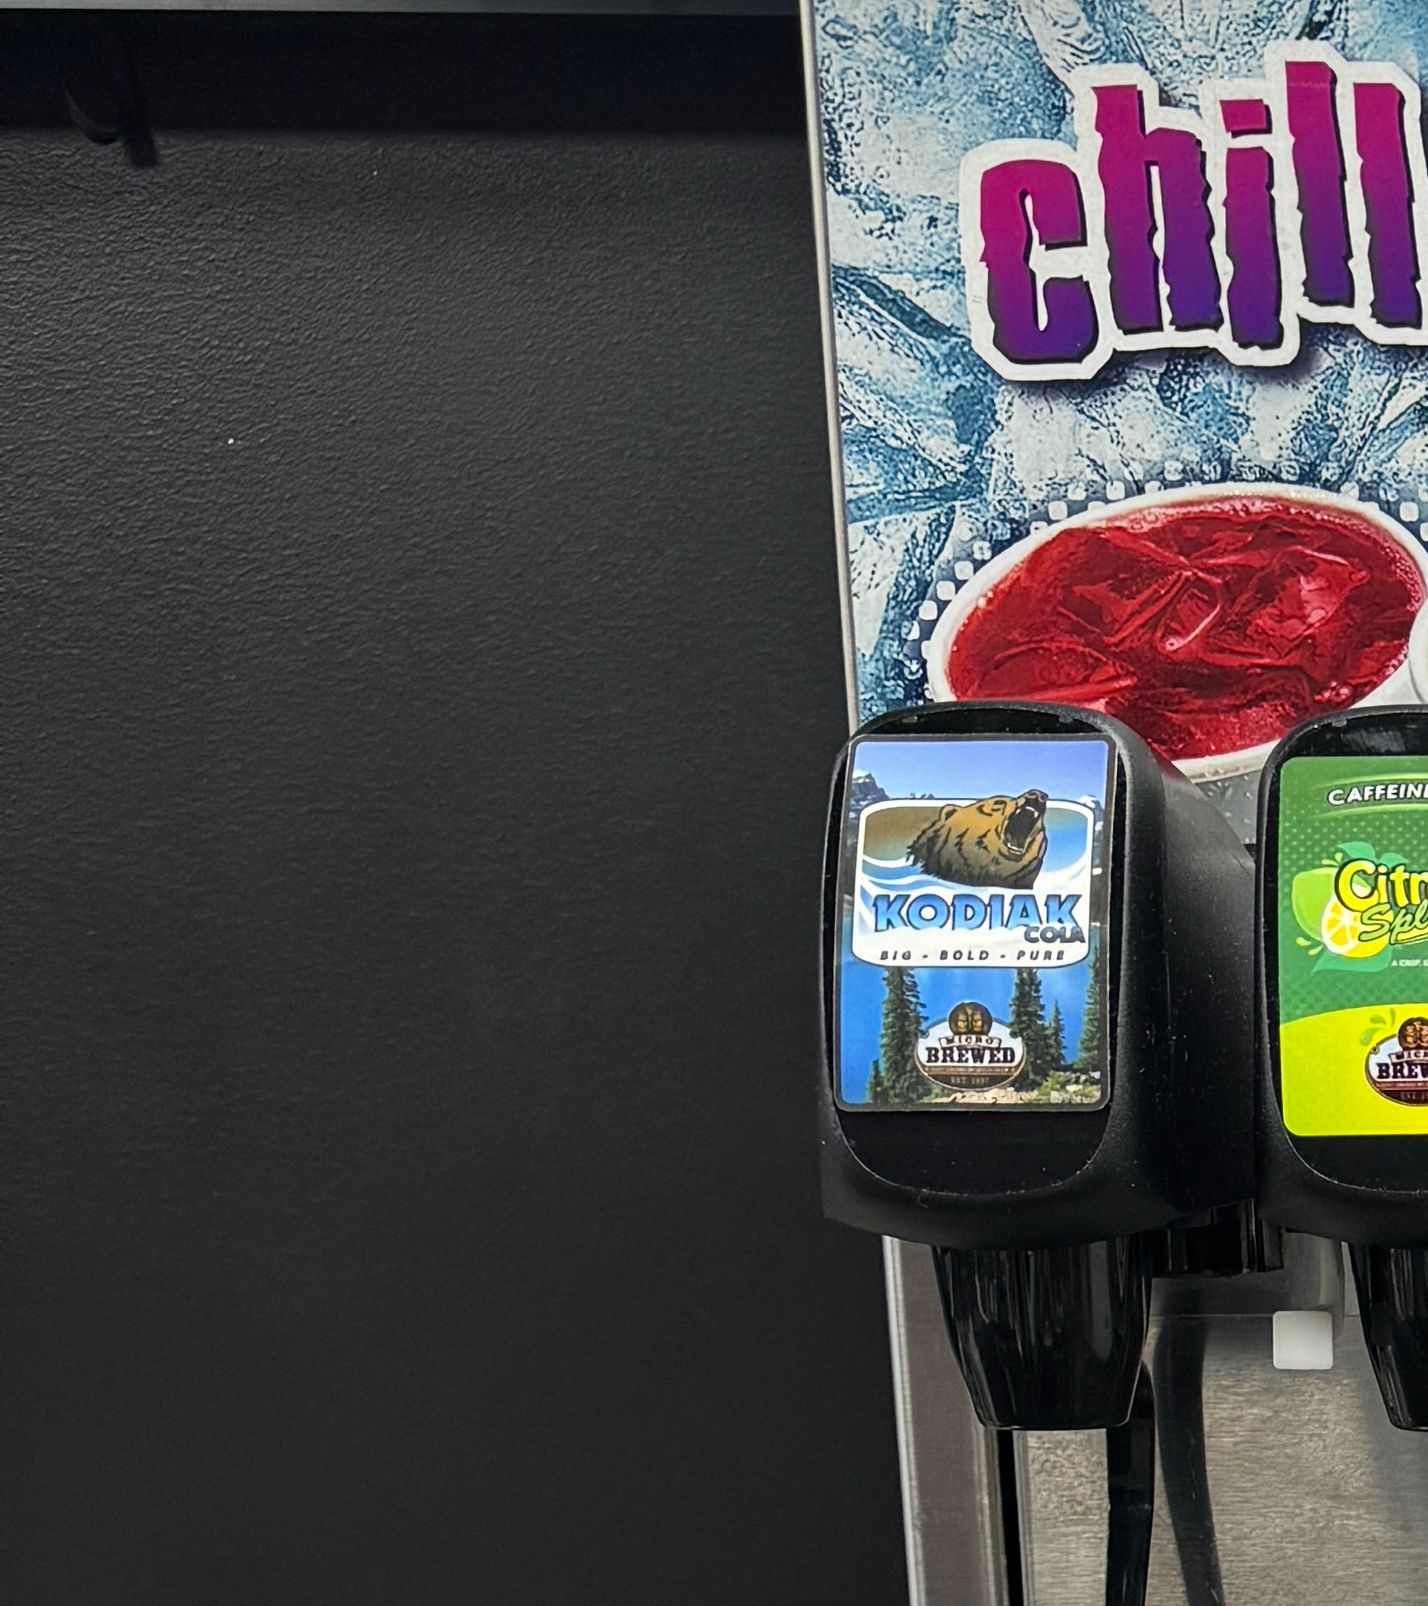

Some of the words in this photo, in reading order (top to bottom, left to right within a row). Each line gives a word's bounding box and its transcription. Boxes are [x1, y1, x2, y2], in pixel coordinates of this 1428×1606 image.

[979, 60, 1422, 362] chill
[872, 893, 1083, 932] KODIAK
[1023, 925, 1087, 944] COLA
[880, 950, 912, 961] BIG
[939, 950, 990, 960] BOLD
[1016, 950, 1066, 961] PURE
[925, 1046, 1016, 1065] BREWED
